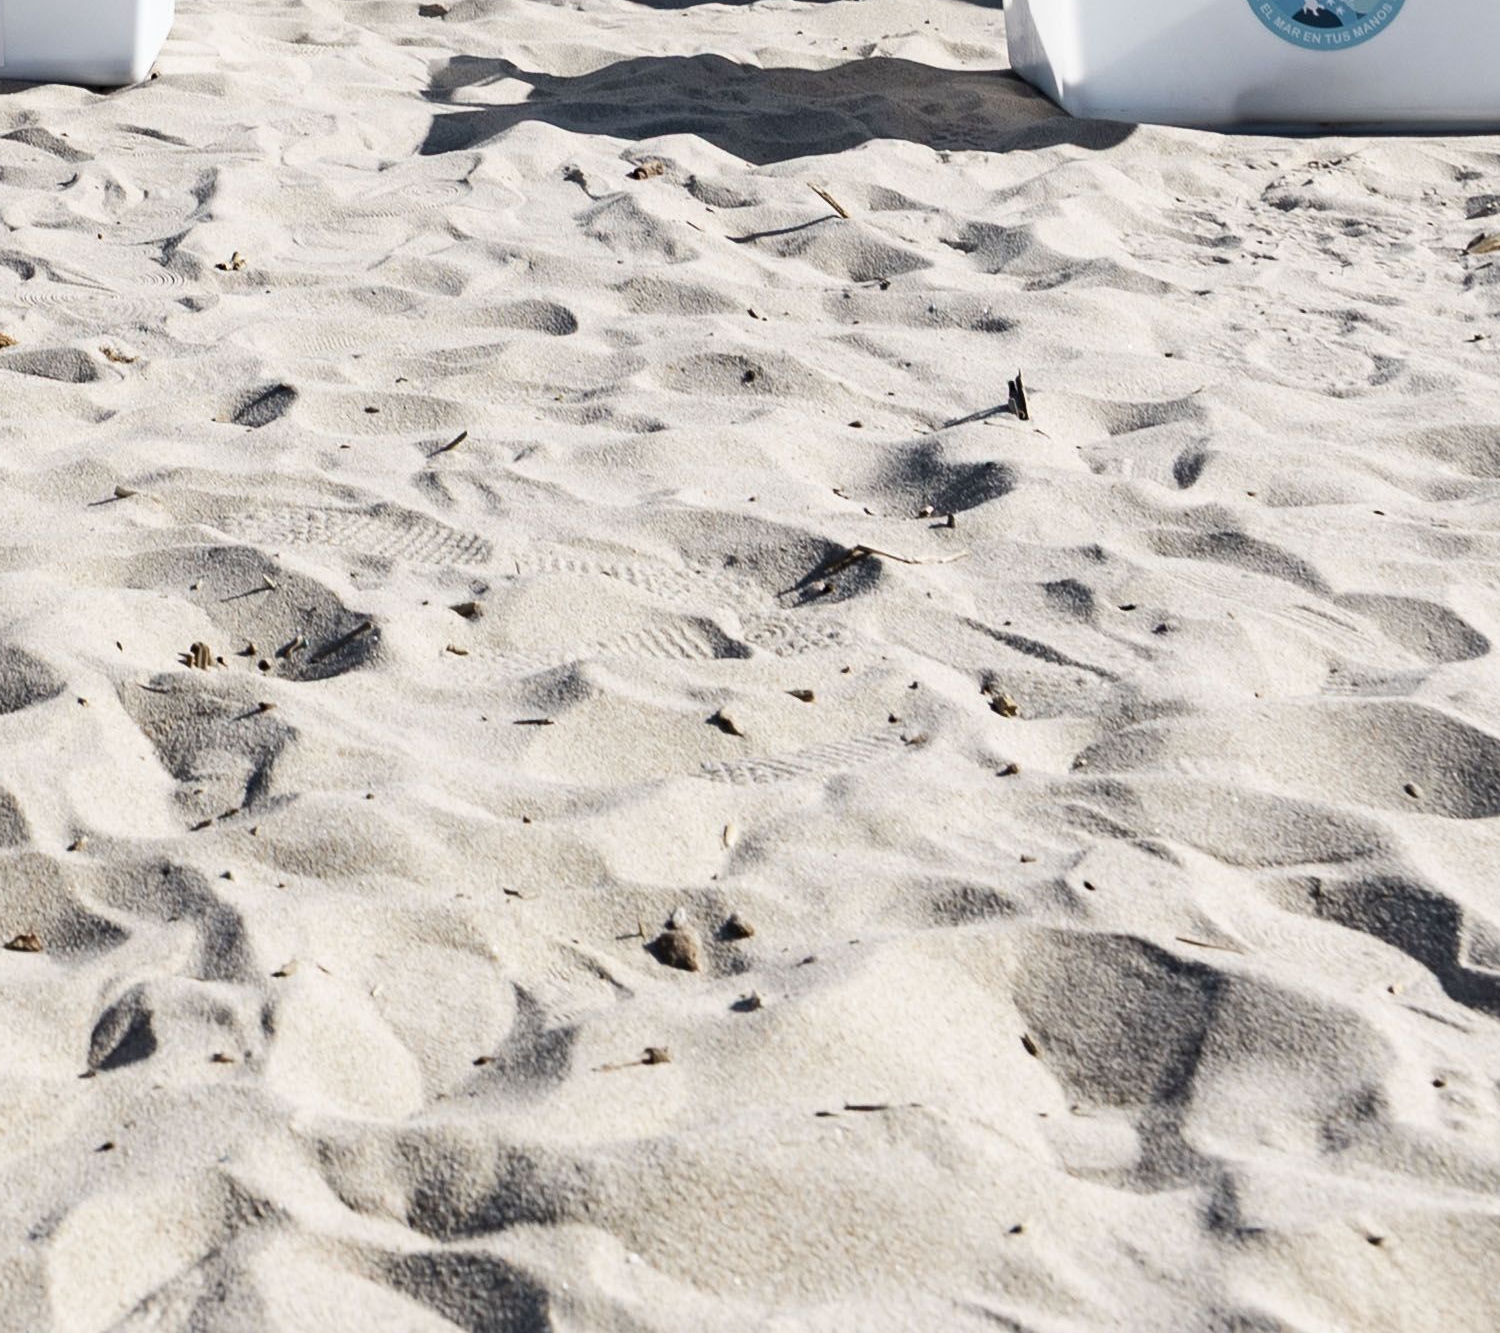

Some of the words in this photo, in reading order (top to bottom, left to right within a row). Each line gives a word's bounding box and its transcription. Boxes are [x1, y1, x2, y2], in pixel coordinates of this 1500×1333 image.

[1259, 2, 1272, 20] EL
[1273, 16, 1300, 39] MAR
[1303, 31, 1321, 44] EN
[1324, 31, 1351, 45] TUS
[1351, 2, 1393, 39] MANOS
